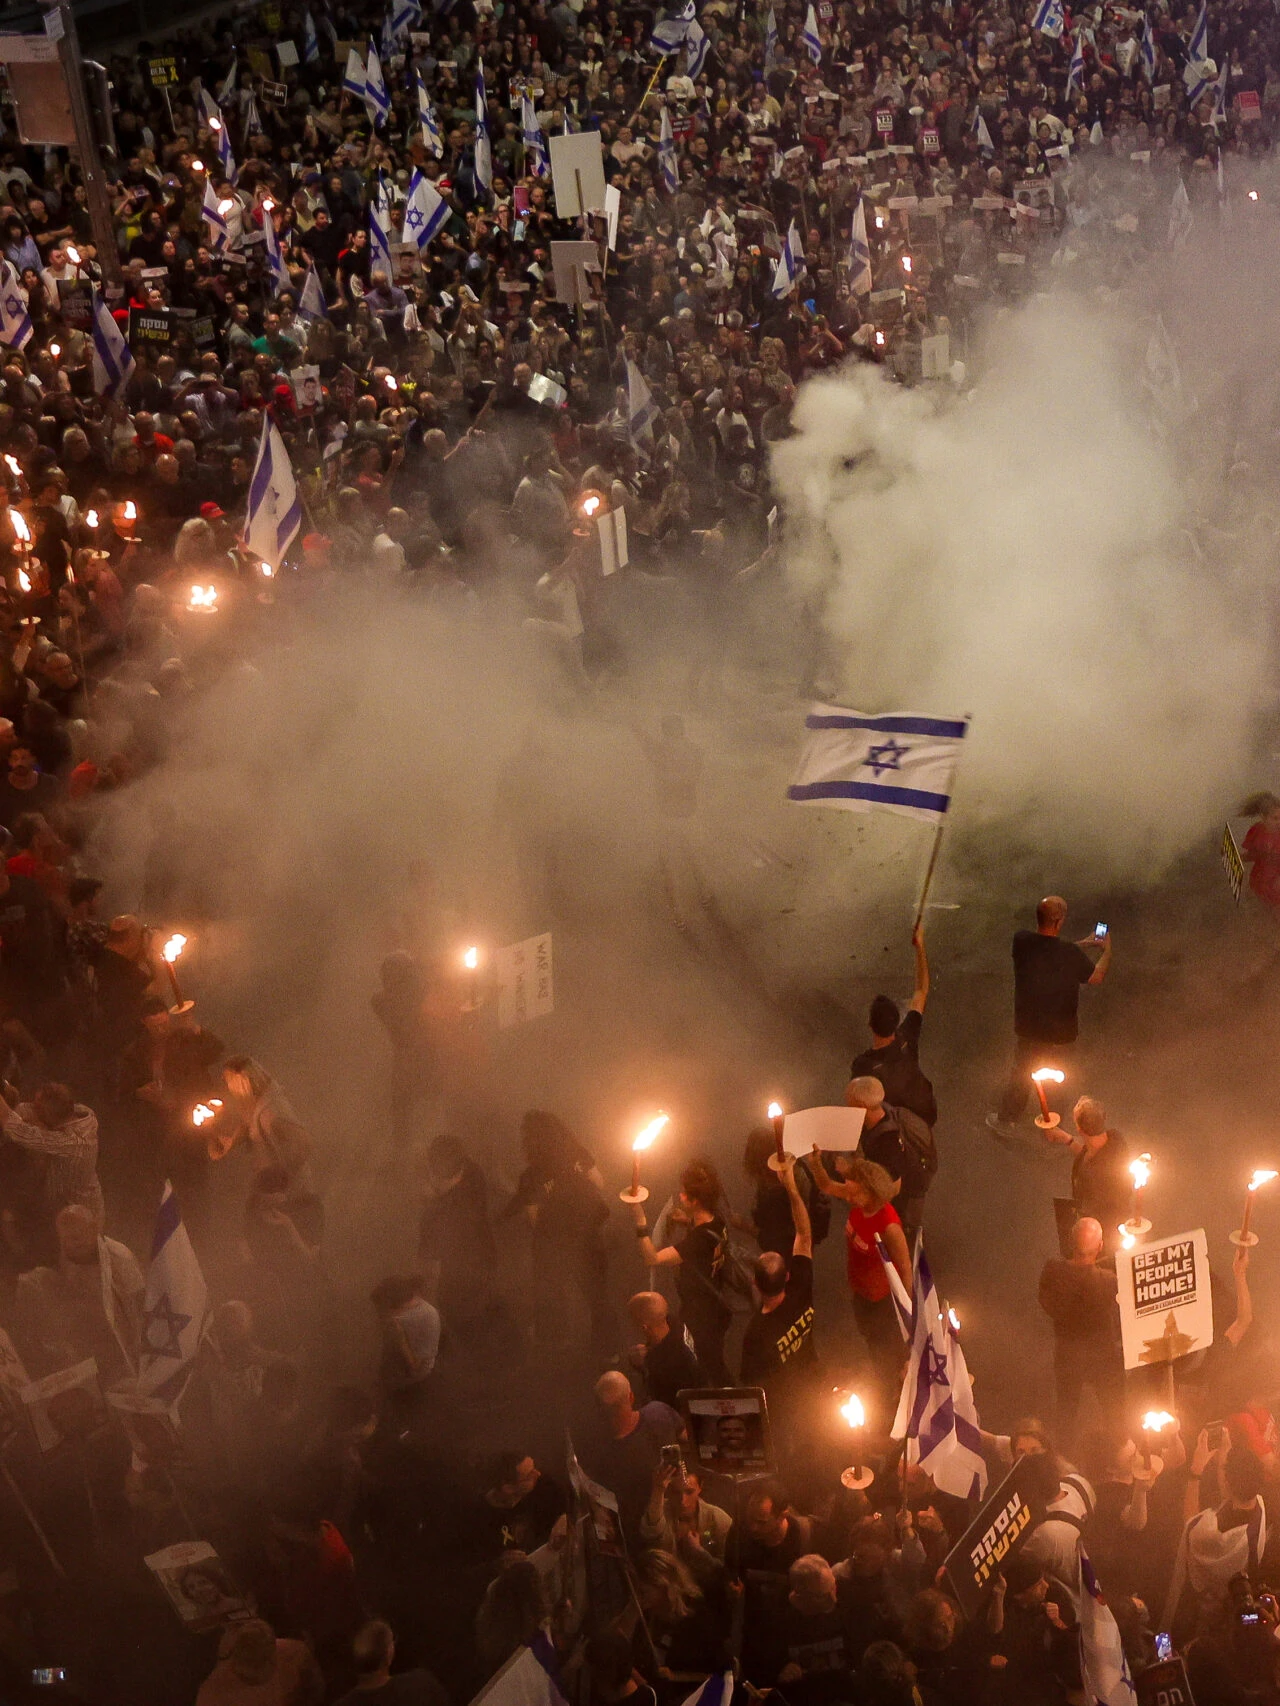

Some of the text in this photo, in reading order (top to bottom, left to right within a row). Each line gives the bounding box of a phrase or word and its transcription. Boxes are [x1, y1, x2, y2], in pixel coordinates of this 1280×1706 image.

[140, 318, 168, 330] עסקה
[535, 941, 550, 971] WAR
[1135, 1242, 1191, 1269] GET MY
[1135, 1258, 1193, 1285] PEOPLE
[1136, 1273, 1194, 1303] HOME!
[970, 1492, 1022, 1568] עסקה
[974, 1504, 1031, 1588] עכשיו!
